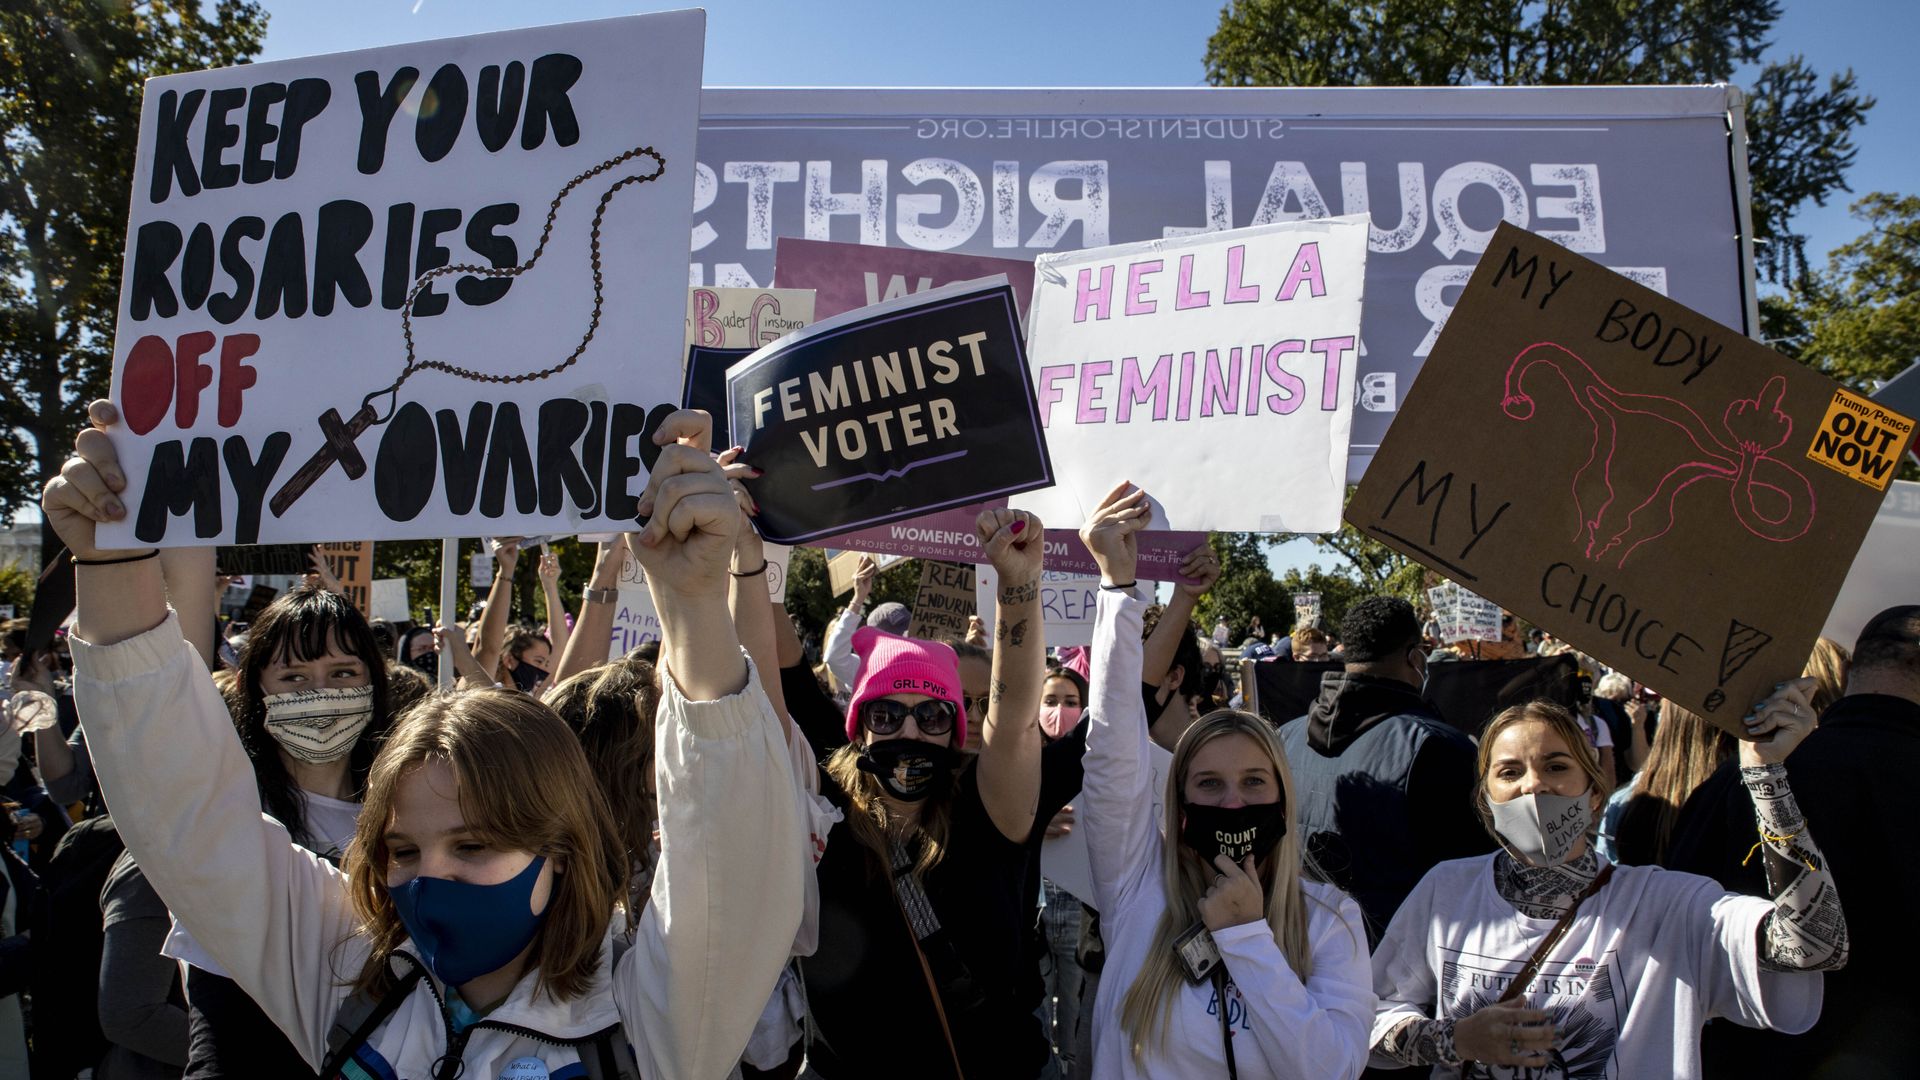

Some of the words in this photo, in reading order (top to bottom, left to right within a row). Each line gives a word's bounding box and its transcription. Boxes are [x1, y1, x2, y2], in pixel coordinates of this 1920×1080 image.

[150, 79, 331, 203] KEEP
[355, 53, 582, 174] YOUR
[130, 200, 519, 324] ROSARIES
[1074, 242, 1327, 323] HELLA
[1492, 246, 1574, 310] MY
[1596, 299, 1723, 385] BODY
[121, 331, 260, 435] OFF
[754, 331, 988, 430] FEMINIST
[1038, 335, 1355, 428] FEMINIST
[800, 397, 960, 468] VOTER
[1832, 412, 1898, 455] OUT
[1835, 392, 1911, 433] Trump/Pence
[1813, 430, 1893, 480] NOW
[135, 431, 292, 544] MY
[1382, 460, 1511, 560] MY
[855, 539, 898, 551] PROJECT
[902, 544, 914, 552] OF
[919, 546, 954, 557] WOMEN
[958, 550, 977, 559] FOR
[929, 563, 974, 592] REAL
[913, 608, 963, 629] HAPPENS
[917, 585, 977, 617] ENDURIN
[1041, 588, 1097, 619] REA
[893, 679, 919, 689] GRL
[923, 681, 947, 697] PWR
[1215, 827, 1257, 845] COUNT
[1546, 801, 1583, 834] BLACK
[1555, 818, 1585, 847] LIVES
[1219, 844, 1234, 857] ON
[1471, 973, 1537, 993] FUTE
[1543, 979, 1561, 994] IS
